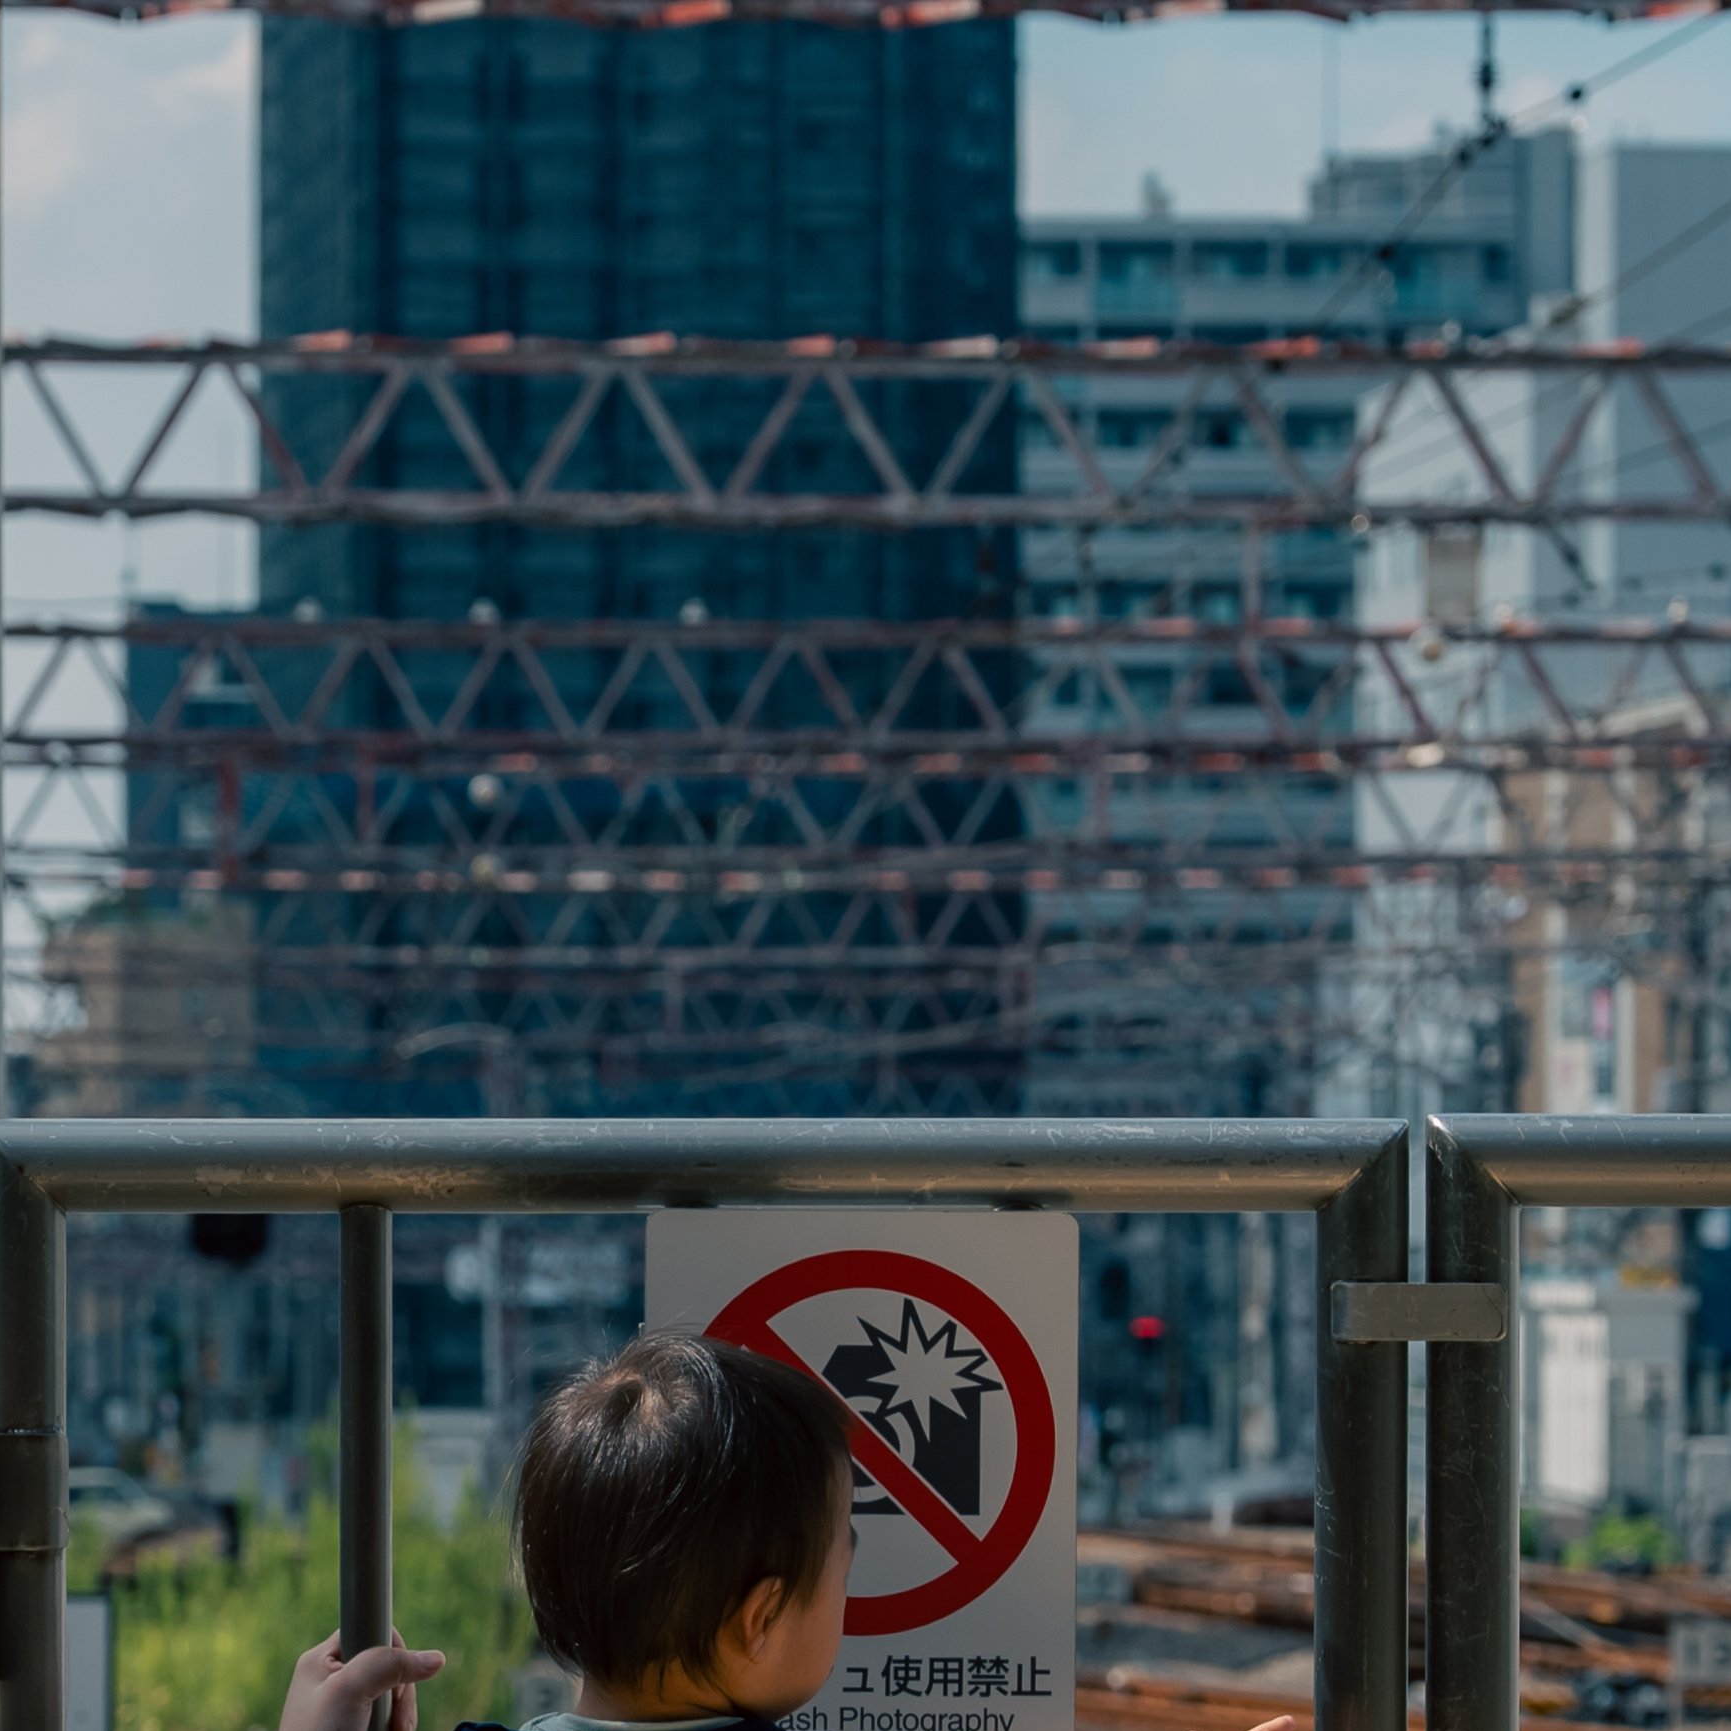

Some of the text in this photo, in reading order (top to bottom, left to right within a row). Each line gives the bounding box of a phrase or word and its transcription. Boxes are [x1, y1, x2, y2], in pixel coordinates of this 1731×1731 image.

[841, 1655, 1052, 1698] ュ使用禁止
[779, 1706, 828, 1731] ash
